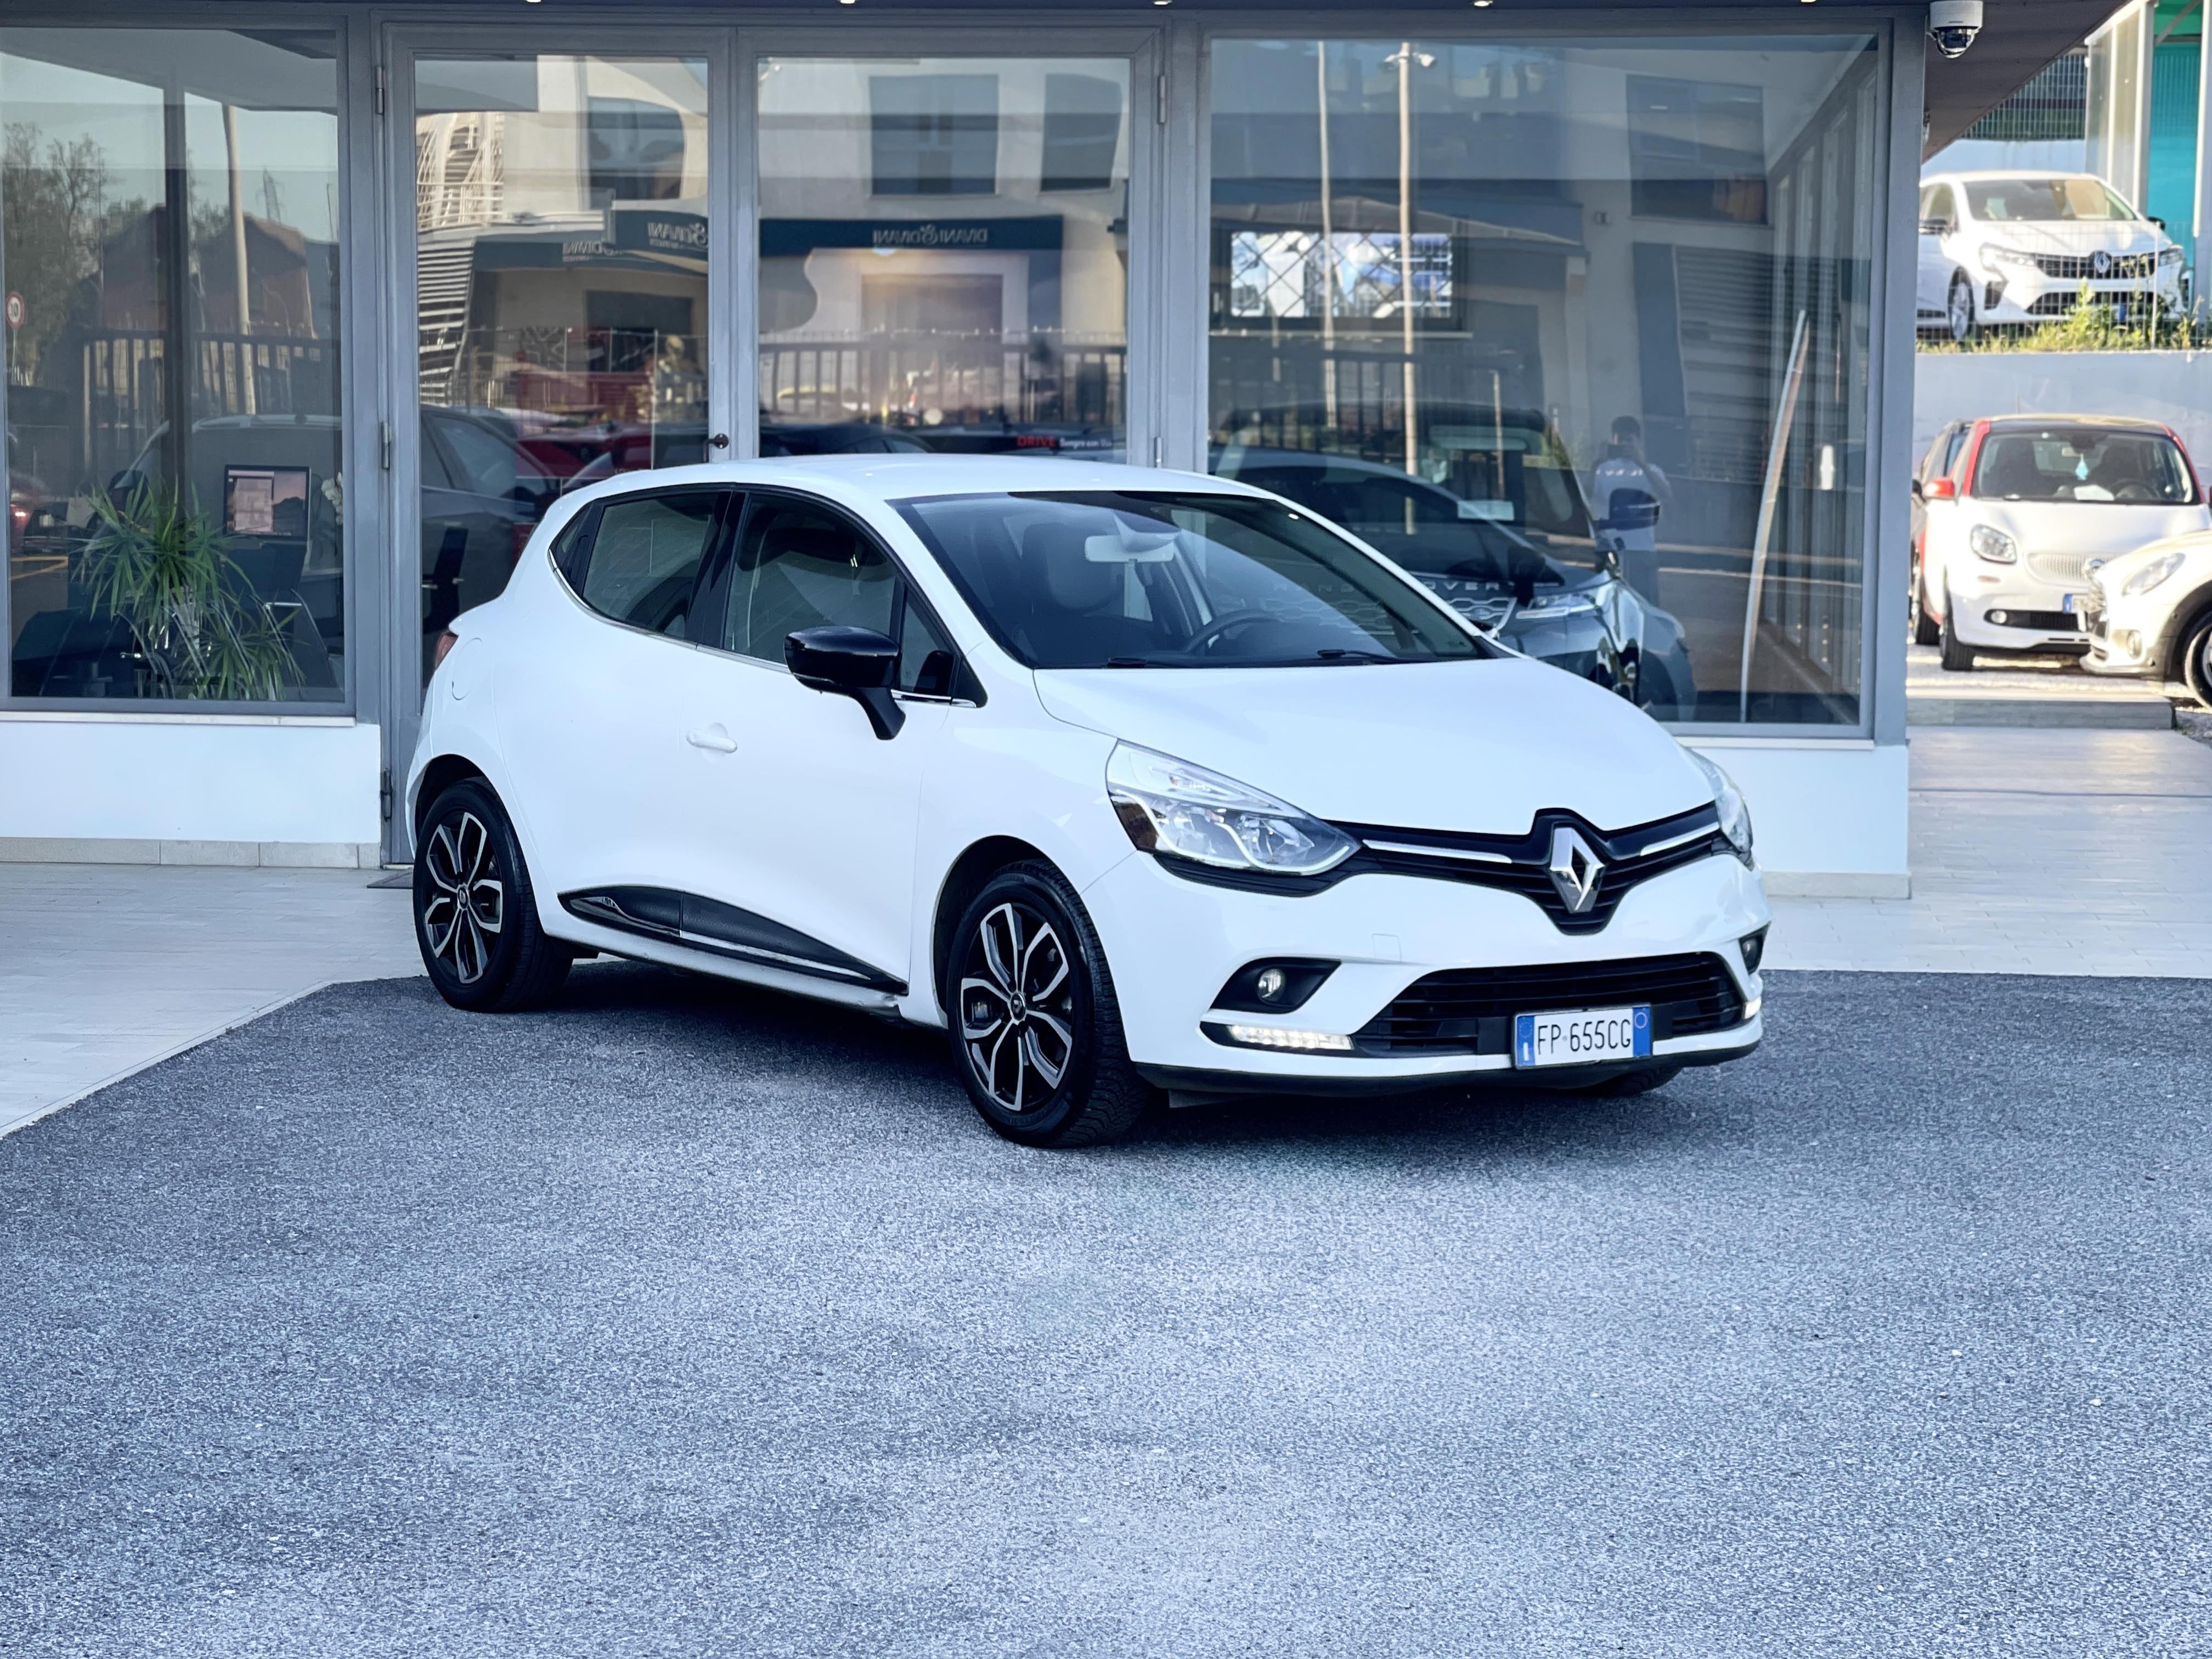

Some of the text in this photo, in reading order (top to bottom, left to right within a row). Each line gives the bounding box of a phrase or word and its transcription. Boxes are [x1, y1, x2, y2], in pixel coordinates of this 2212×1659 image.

[1017, 436, 1055, 447] DRIVE
[1537, 1024, 1562, 1056] FP
[1570, 1018, 1631, 1052] 655CG
